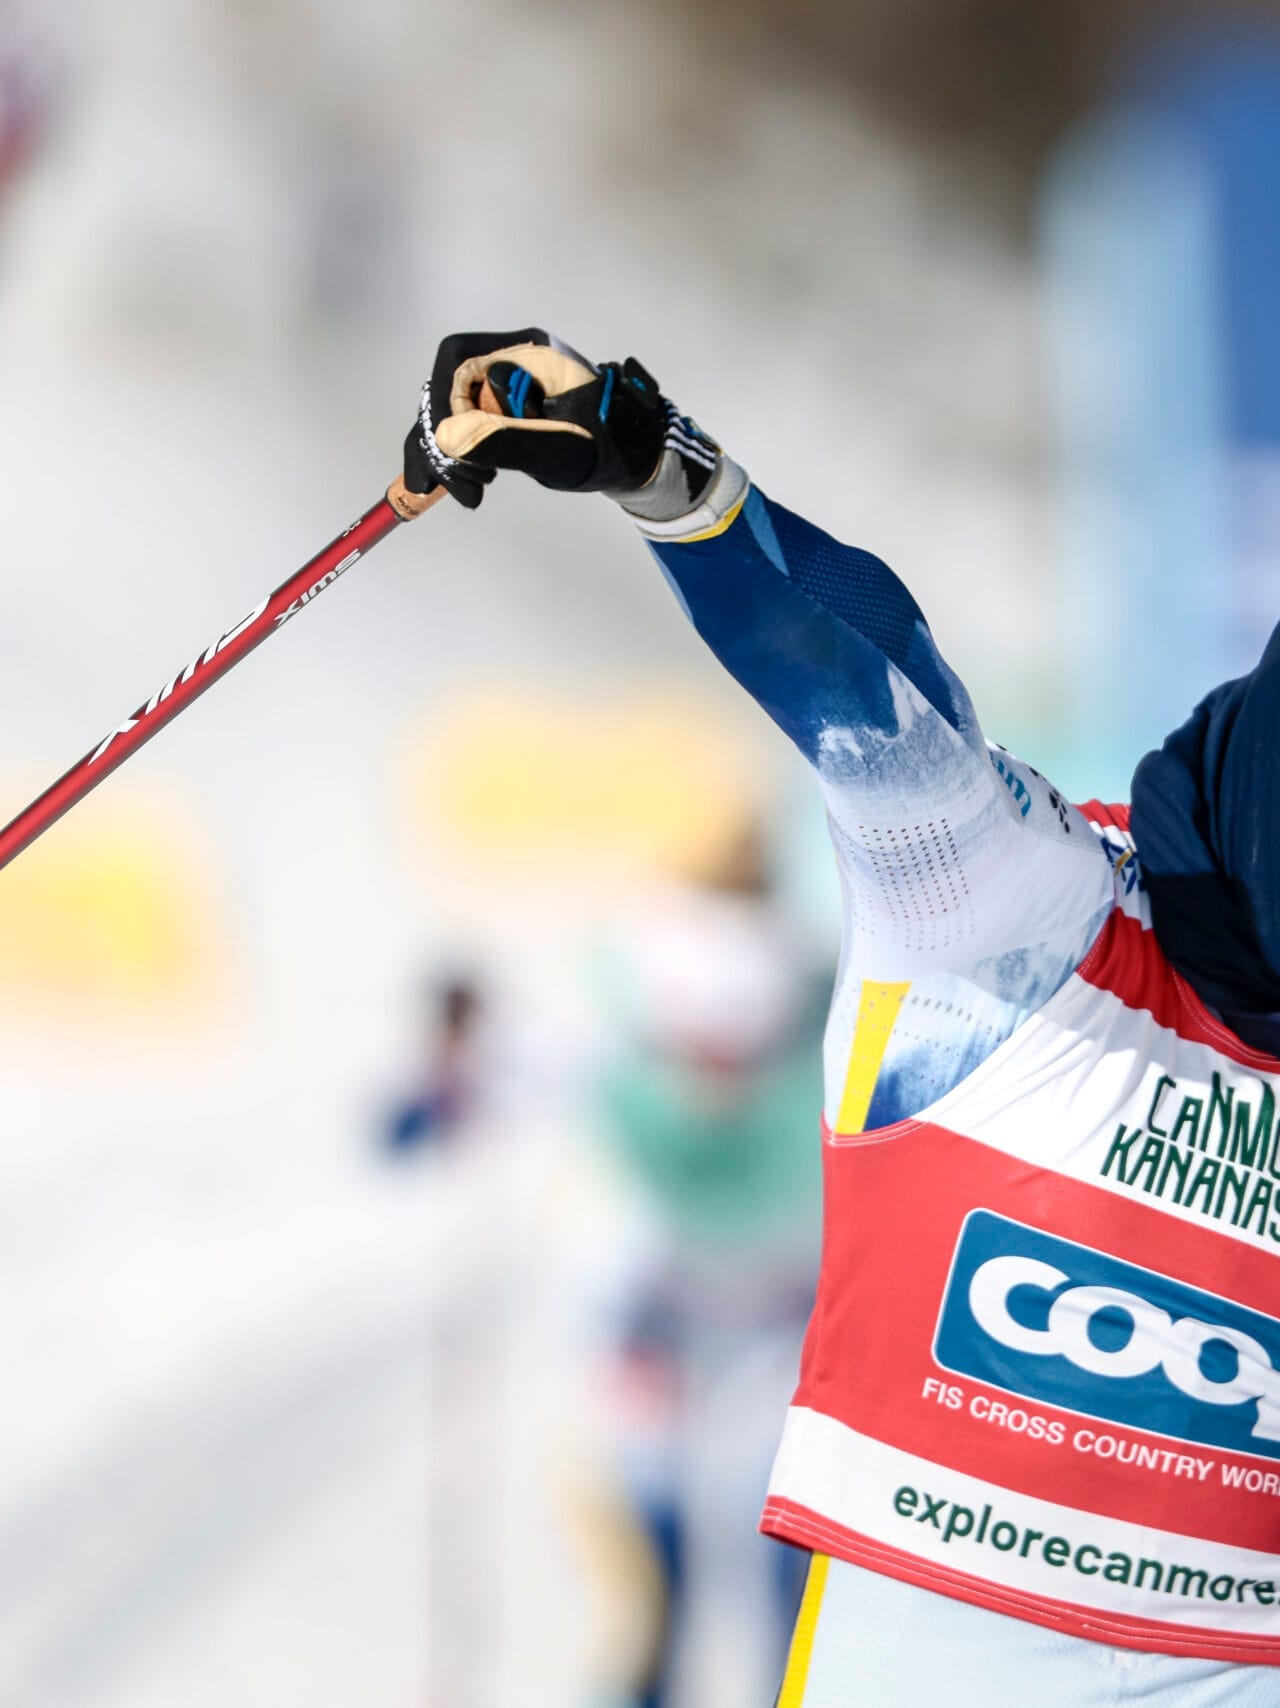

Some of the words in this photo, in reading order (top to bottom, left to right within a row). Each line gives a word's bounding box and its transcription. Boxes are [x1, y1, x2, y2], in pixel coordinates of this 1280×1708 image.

[274, 548, 361, 626] SWIX
[921, 1377, 964, 1409] FIS
[968, 1395, 1067, 1446] CROSS
[1072, 1429, 1216, 1482] COUNTRY
